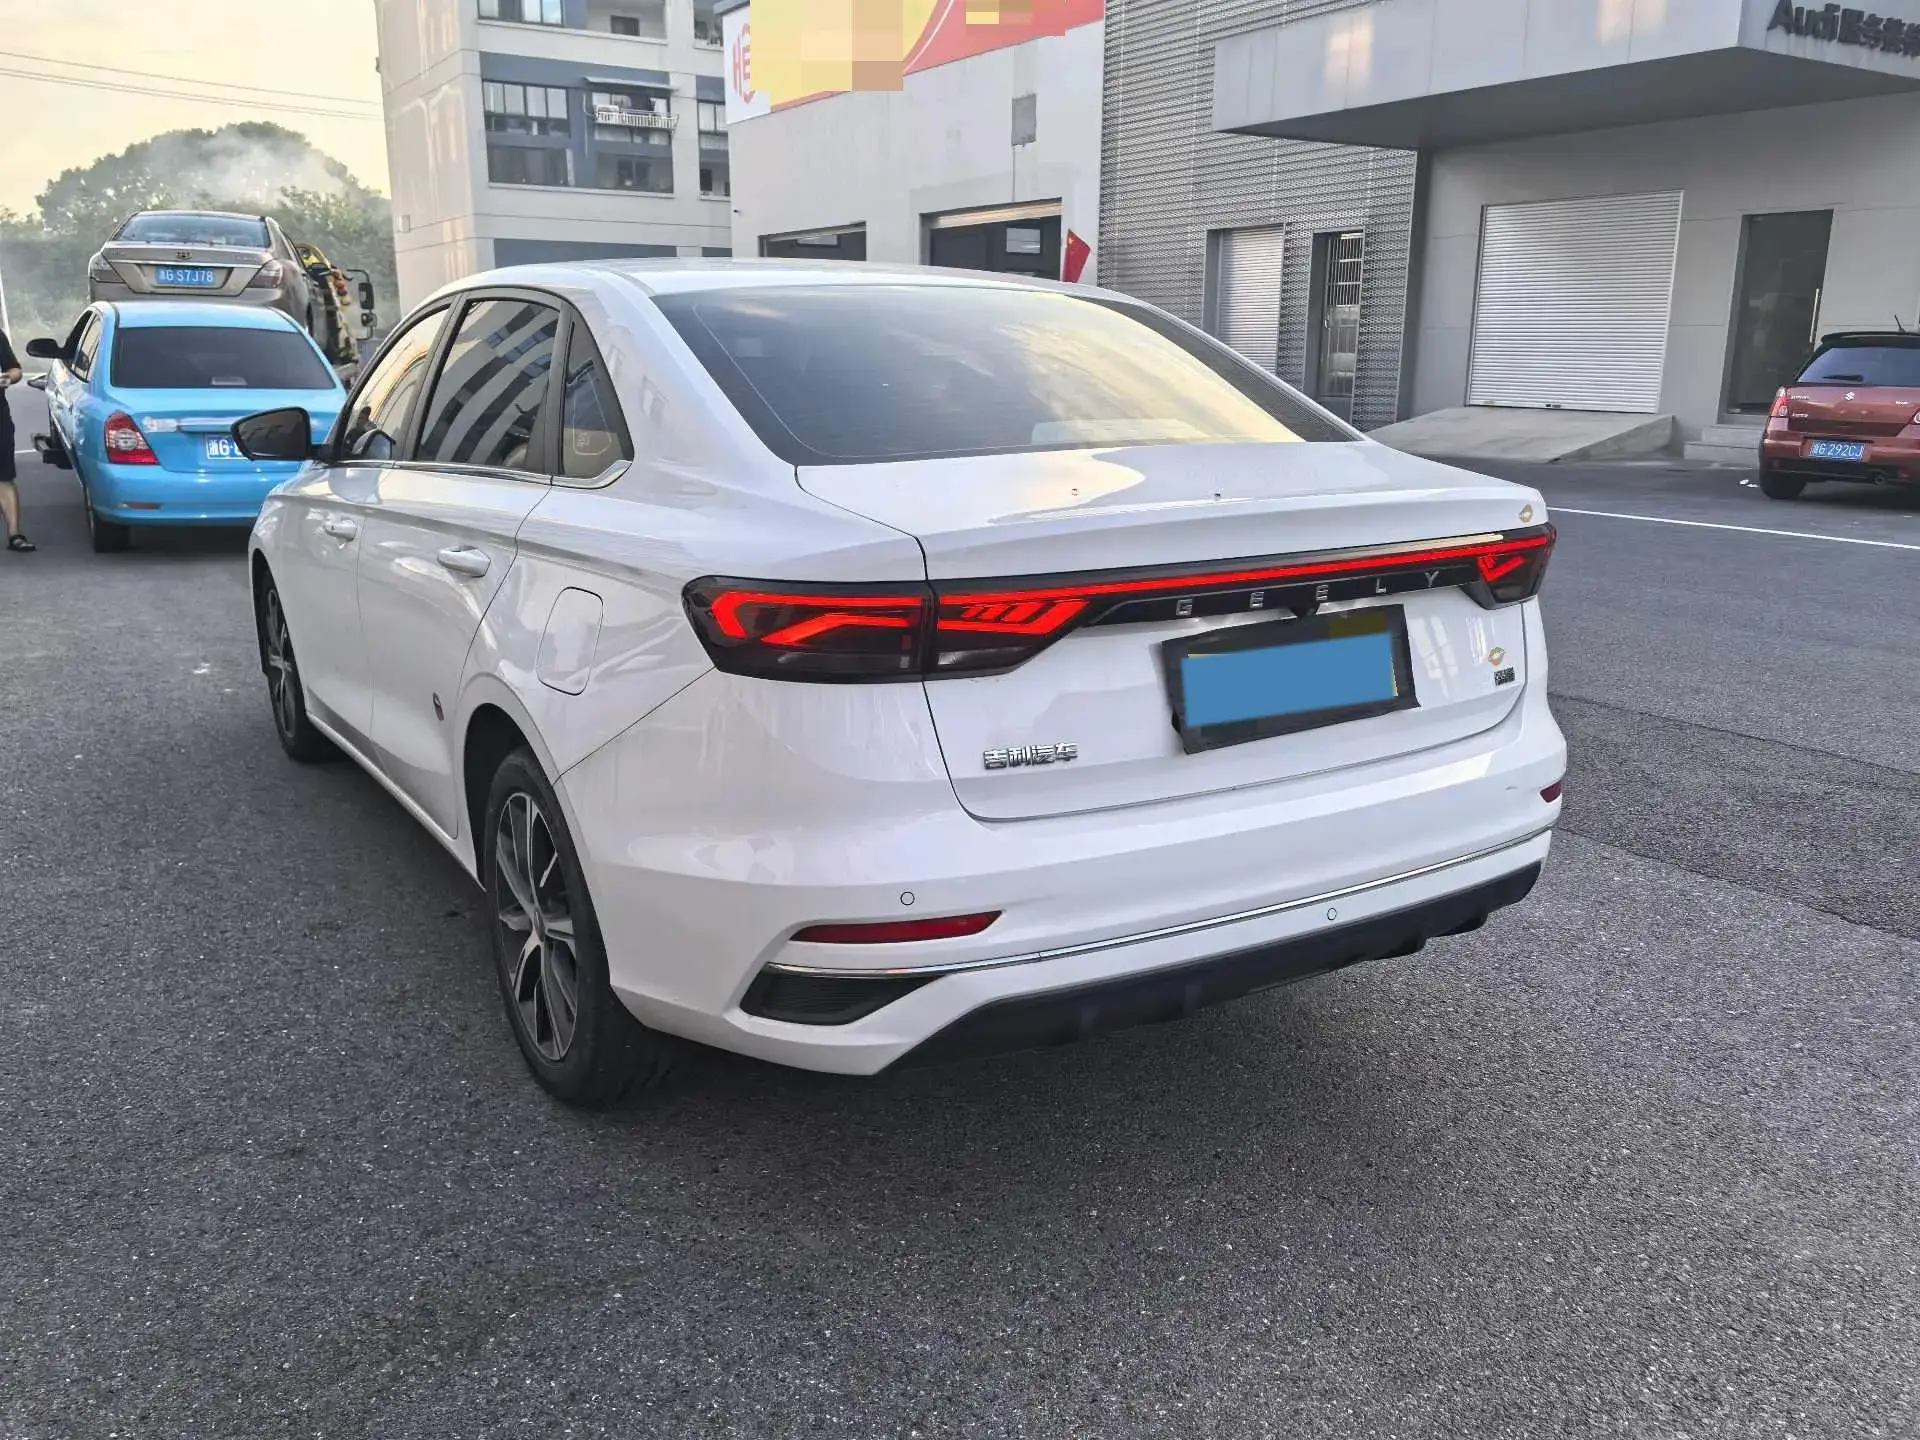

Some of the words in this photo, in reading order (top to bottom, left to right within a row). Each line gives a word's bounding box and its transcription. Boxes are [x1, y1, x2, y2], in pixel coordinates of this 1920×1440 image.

[1175, 570, 1440, 617] GEELY
[984, 742, 1079, 769] 吉利汽车
